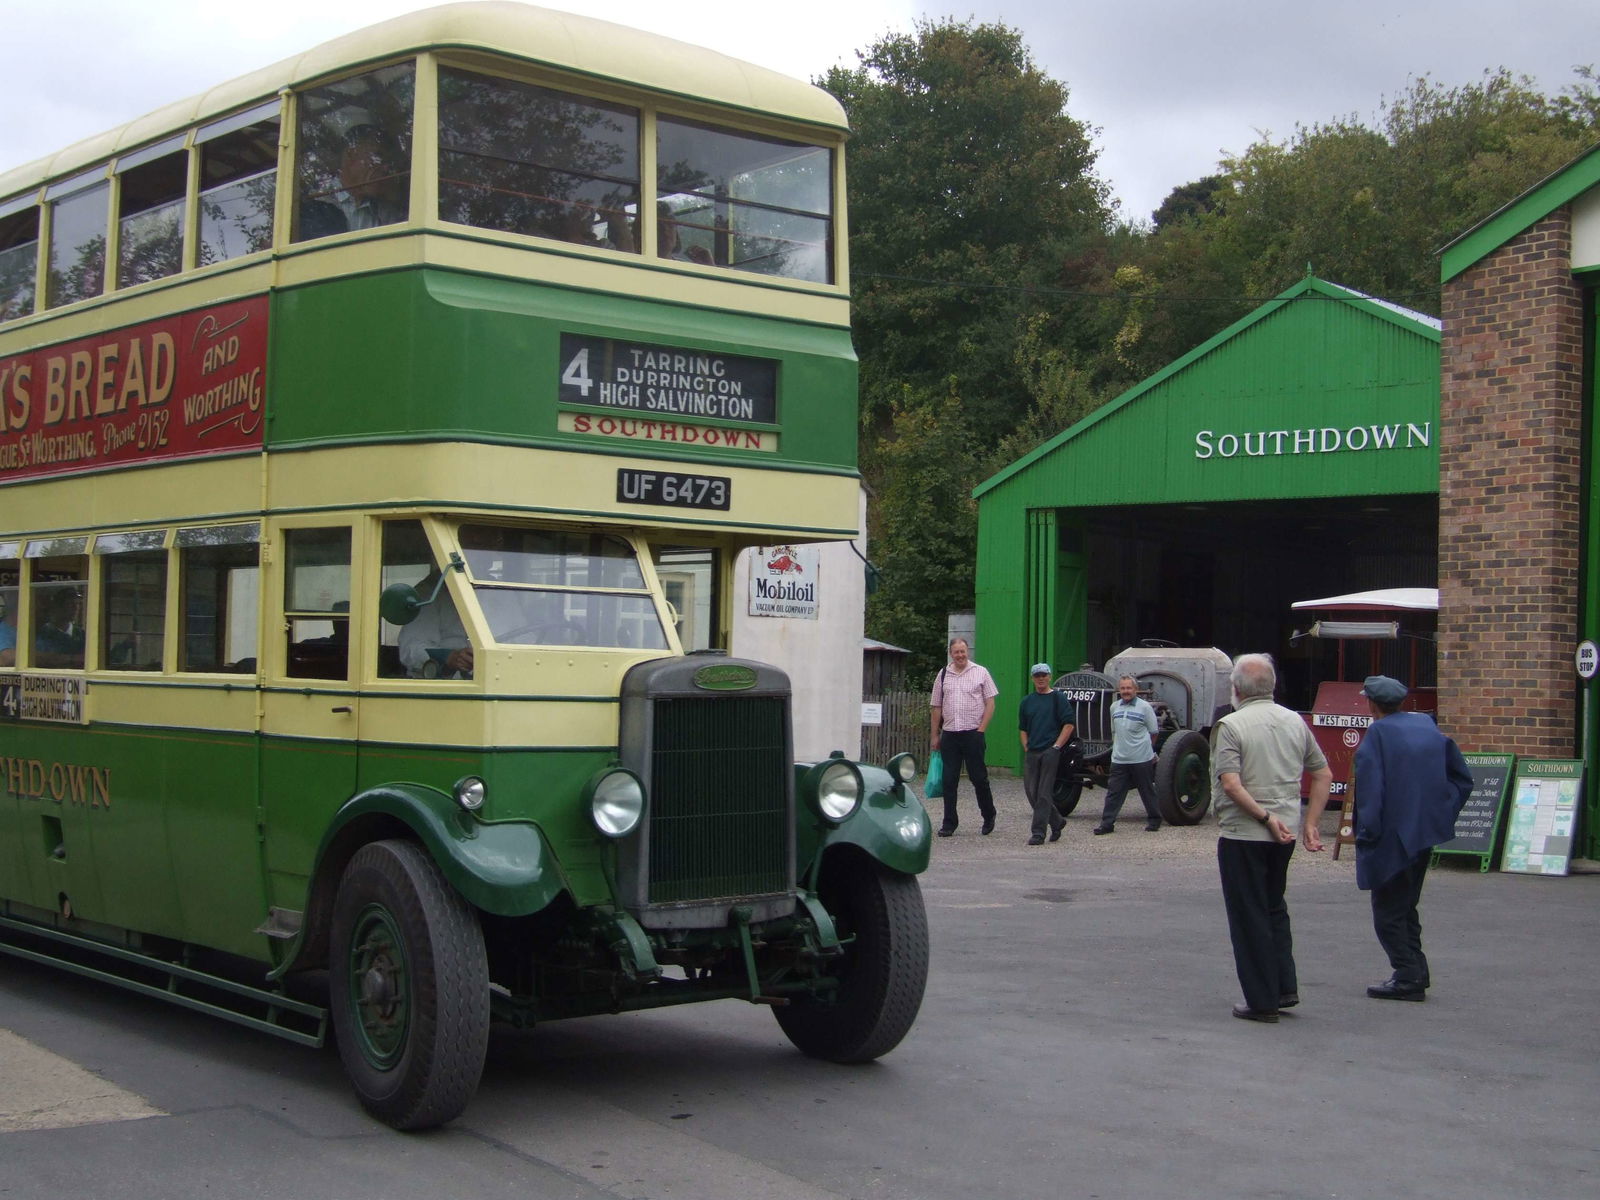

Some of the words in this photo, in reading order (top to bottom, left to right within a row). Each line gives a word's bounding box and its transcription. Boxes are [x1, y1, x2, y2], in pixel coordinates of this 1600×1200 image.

[202, 335, 239, 375] AND
[630, 349, 725, 377] TARRING
[43, 331, 174, 424] BREAD
[562, 348, 593, 396] 4
[616, 367, 742, 396] DURRINGTON
[184, 366, 261, 425] WORTHING
[600, 382, 640, 407] HIGH
[647, 388, 753, 419] SALVINGTON
[138, 409, 169, 450] 2152
[574, 415, 761, 449] SOUTHDOWN
[1195, 422, 1430, 459] SOUTHDOWN
[623, 473, 656, 499] UF
[662, 477, 726, 505] 6473
[756, 578, 814, 602] Mobiloil
[755, 602, 775, 612] VACUUM
[776, 604, 784, 613] OIL
[785, 604, 807, 614] COMPANY
[1580, 662, 1594, 671] STOP
[1581, 649, 1593, 658] BUS
[25, 677, 80, 695] DURRINGTON
[3, 686, 17, 716] 4
[1319, 715, 1340, 726] WEST
[1350, 716, 1370, 727] EAST
[1345, 732, 1357, 743] SD
[1465, 755, 1506, 765] SOUTHDOWN
[1528, 764, 1574, 773] SOUTHDOWN
